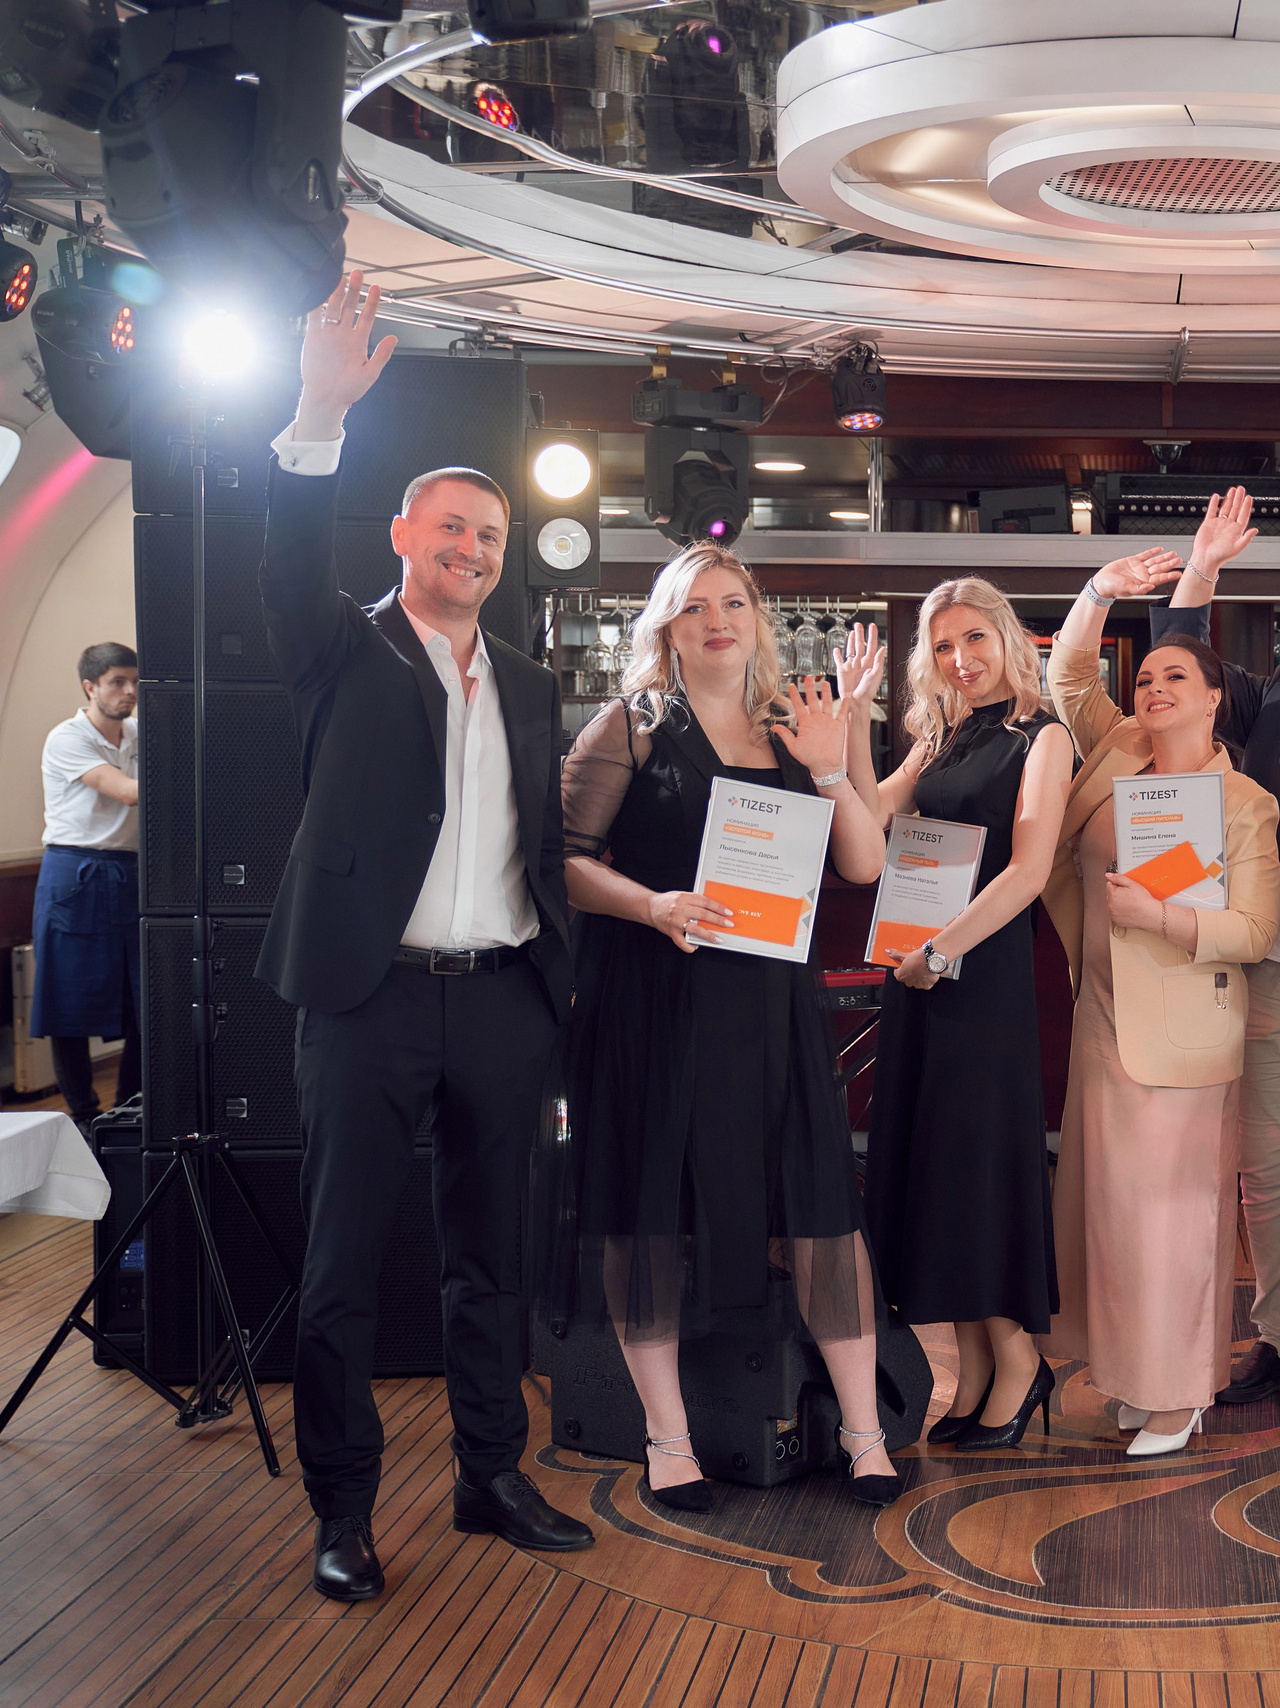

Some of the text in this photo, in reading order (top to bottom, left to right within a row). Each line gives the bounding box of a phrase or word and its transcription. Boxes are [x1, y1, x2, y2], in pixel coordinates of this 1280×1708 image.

[1139, 789, 1178, 801] TIZEST
[740, 797, 782, 815] TIZEST
[912, 830, 943, 844] TIZEST
[758, 850, 779, 861] Дарья
